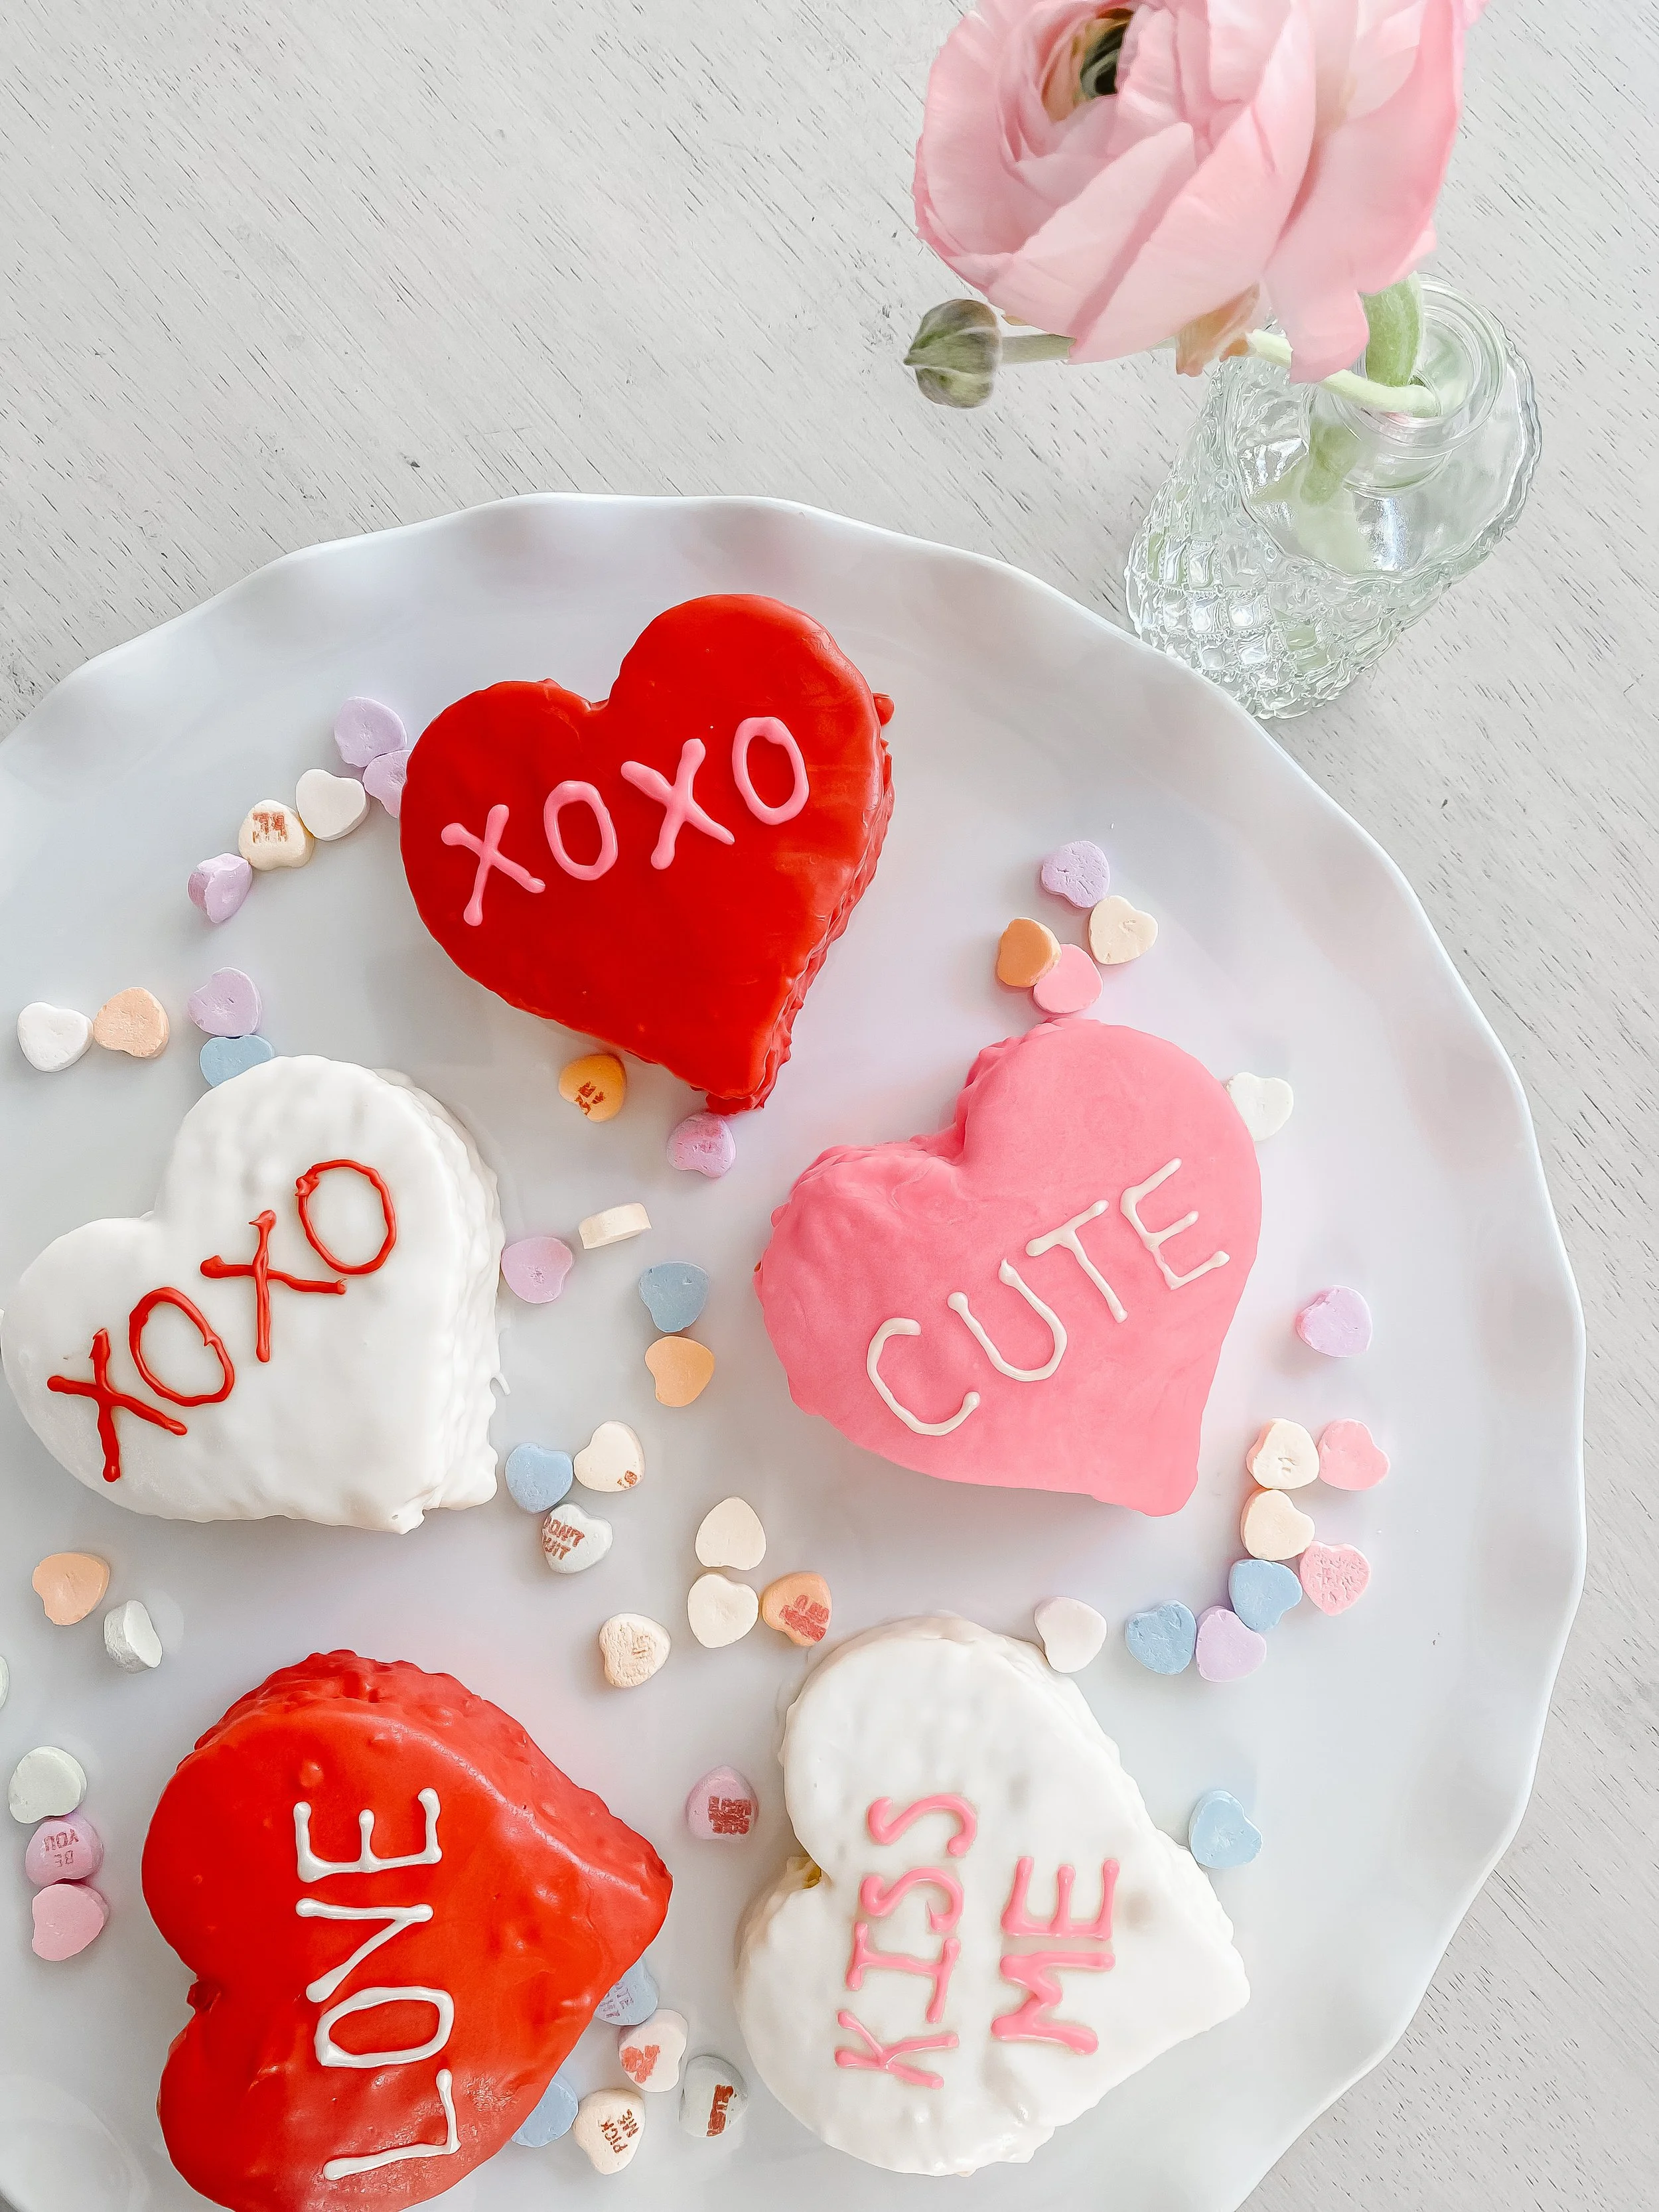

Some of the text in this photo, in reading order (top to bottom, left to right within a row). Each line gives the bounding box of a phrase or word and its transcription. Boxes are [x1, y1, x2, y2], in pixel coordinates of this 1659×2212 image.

[441, 717, 810, 926] XOXO
[47, 1158, 397, 1483] XOXO
[867, 1158, 1232, 1438] CUTE
[43, 1828, 80, 1852] YOU
[834, 1794, 977, 2089] KISS
[294, 1787, 462, 2181] LOVE
[989, 1856, 1121, 2055] ME
[599, 2115, 628, 2154] PICK
[617, 2108, 640, 2138] ME
